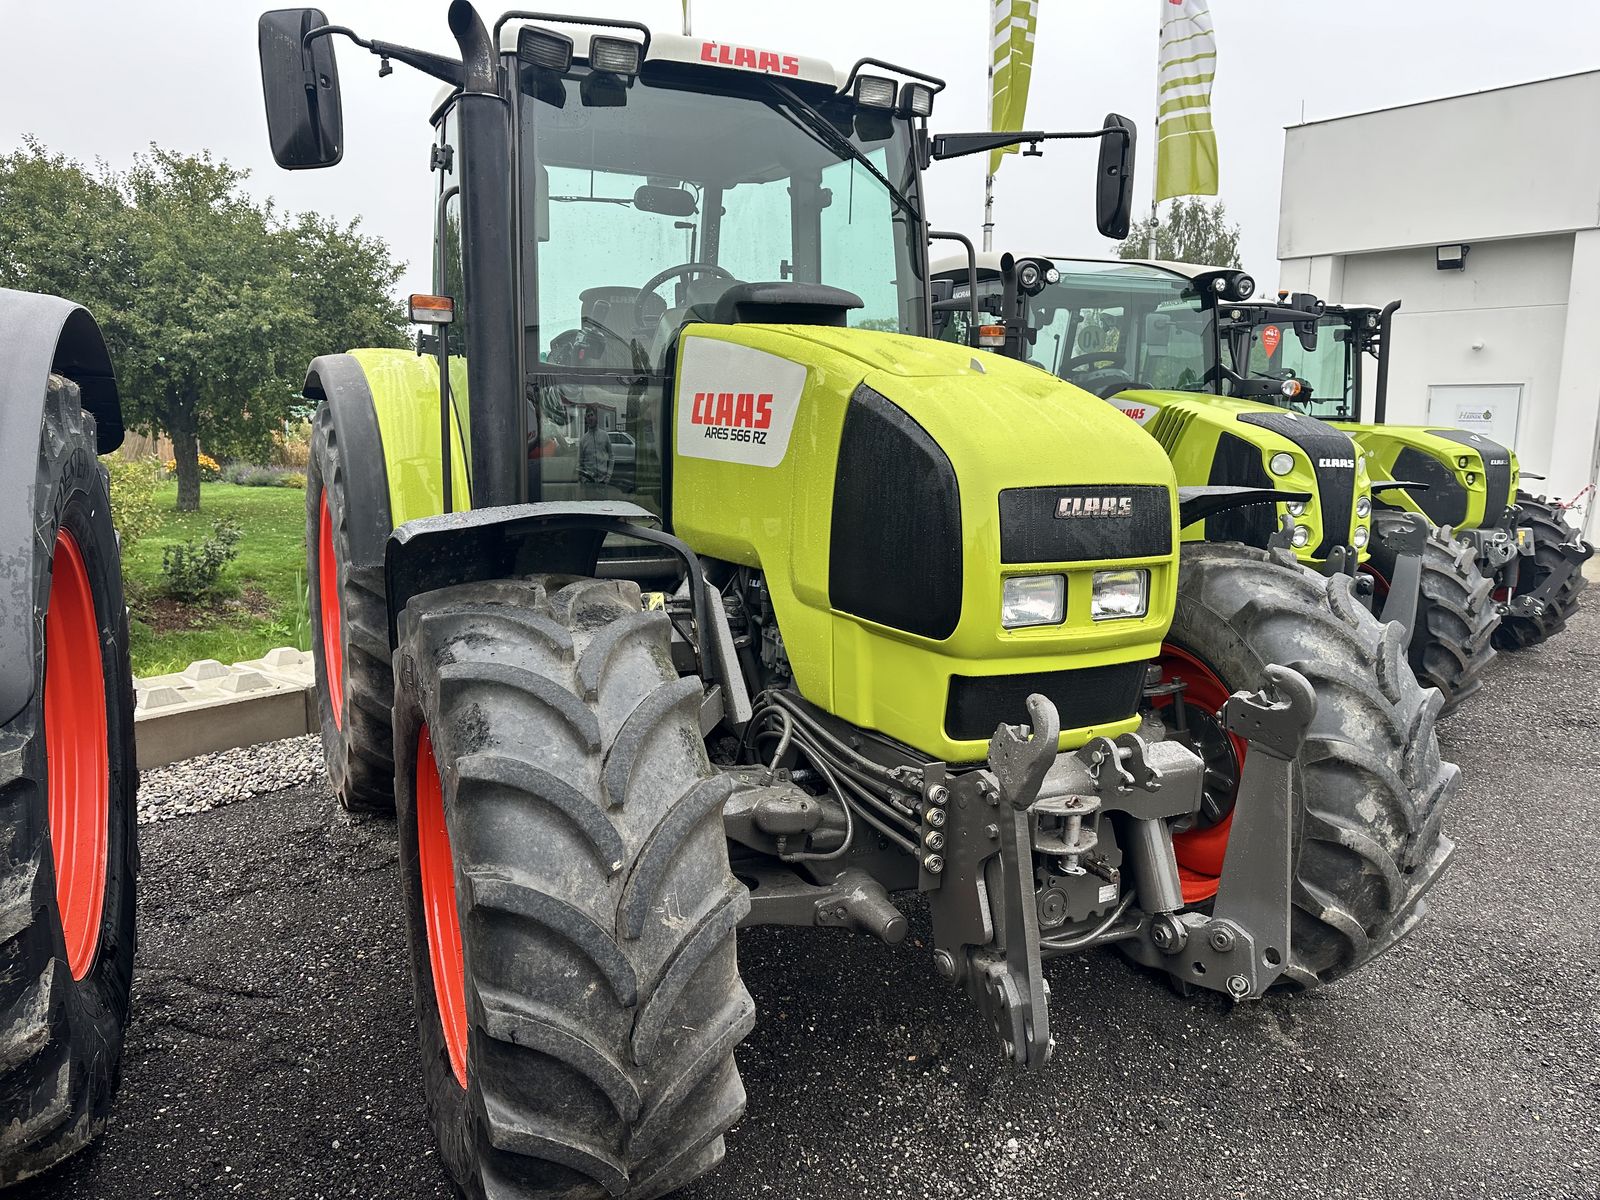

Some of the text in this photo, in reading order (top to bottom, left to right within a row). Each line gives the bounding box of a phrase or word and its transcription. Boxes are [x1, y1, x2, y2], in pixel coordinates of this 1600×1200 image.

[700, 42, 799, 76] CLAAS
[691, 392, 773, 429] CLAAS
[704, 426, 768, 445] ARES 566 RZ
[1318, 458, 1354, 469] CLAAS
[1056, 497, 1133, 520] CLAAS
